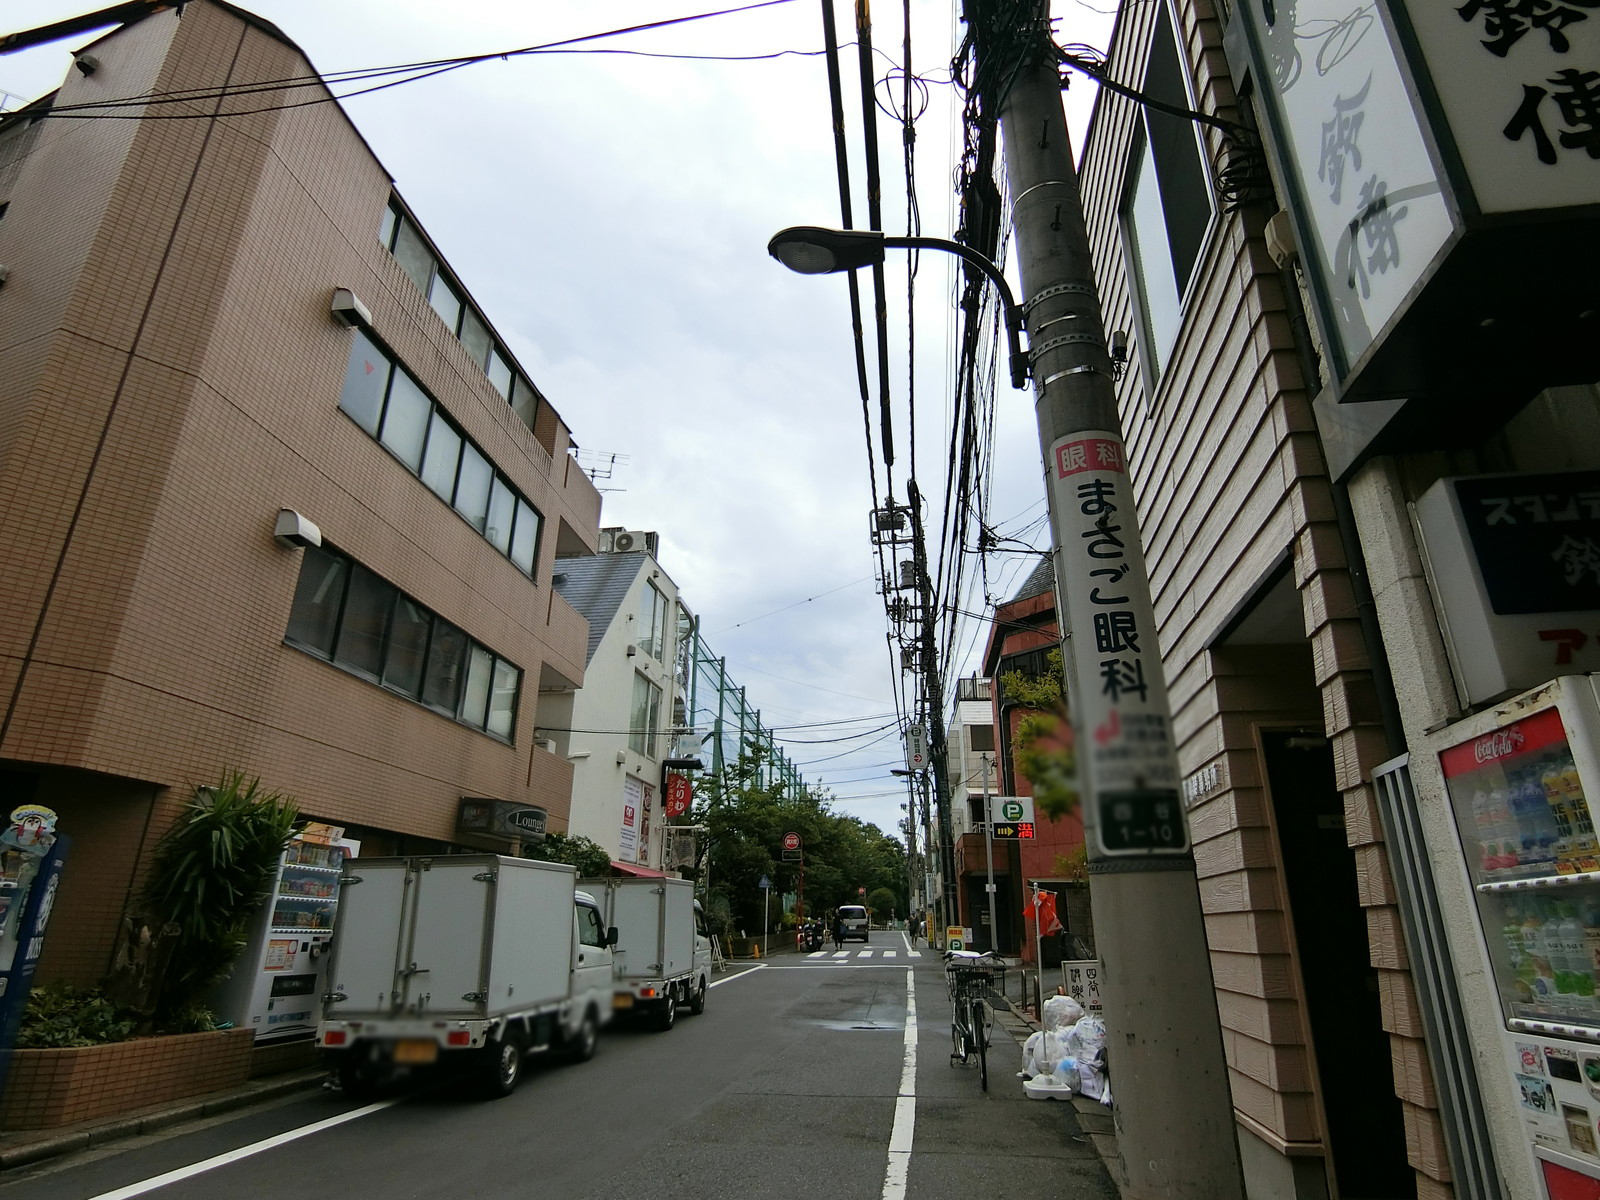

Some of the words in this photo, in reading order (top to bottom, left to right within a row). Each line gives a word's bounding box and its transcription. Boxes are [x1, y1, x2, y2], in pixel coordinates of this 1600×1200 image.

[1060, 440, 1121, 471] 眼科
[1076, 478, 1149, 704] まさご眼科
[674, 778, 686, 811] たりむ
[1017, 823, 1033, 838] 満
[1120, 825, 1172, 842] 1-10
